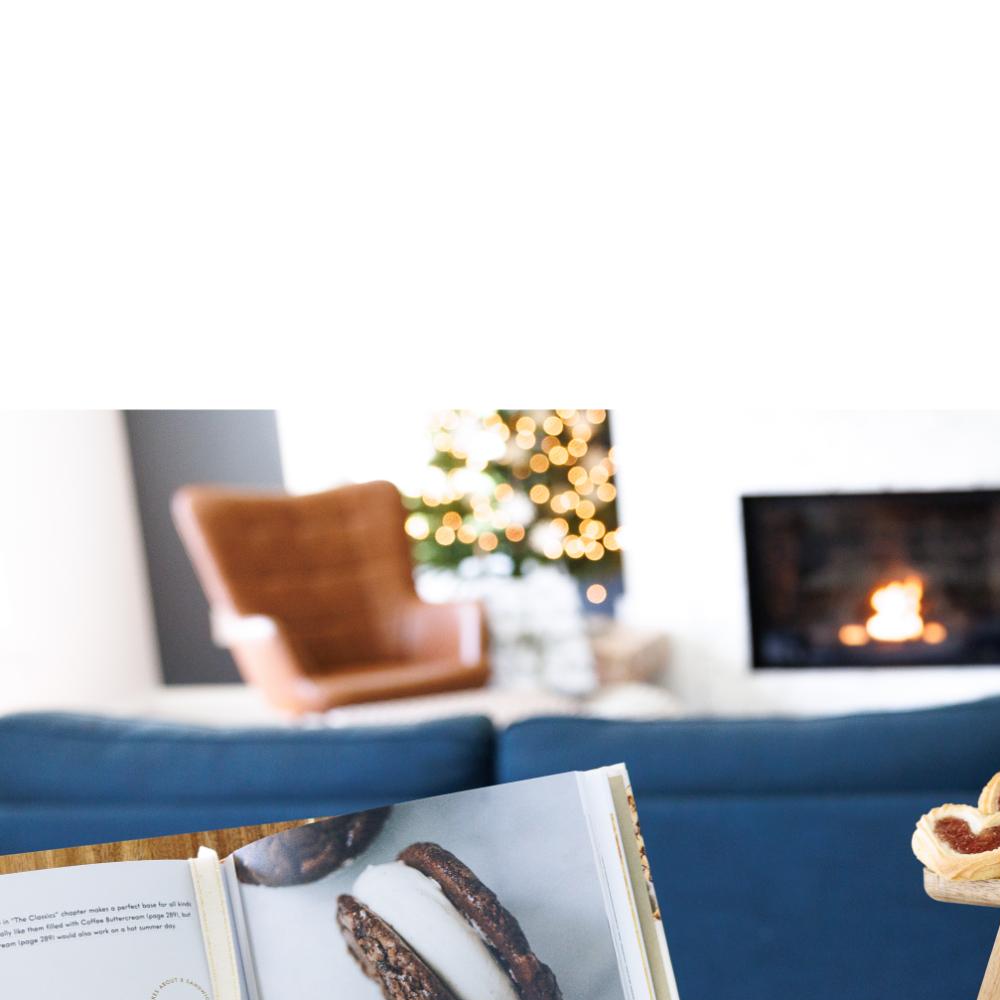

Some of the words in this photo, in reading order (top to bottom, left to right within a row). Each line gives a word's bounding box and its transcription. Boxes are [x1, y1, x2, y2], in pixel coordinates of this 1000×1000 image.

[61, 909, 86, 918] chapter
[89, 905, 109, 914] makes
[117, 903, 140, 912] perfect
[142, 901, 157, 909] base
[46, 922, 63, 930] filled
[65, 920, 79, 928] with
[81, 917, 104, 926] Coffee
[106, 914, 145, 923] Buttercream
[57, 932, 76, 940] would
[78, 930, 92, 938] also
[94, 927, 109, 936] work
[127, 924, 137, 932] hot
